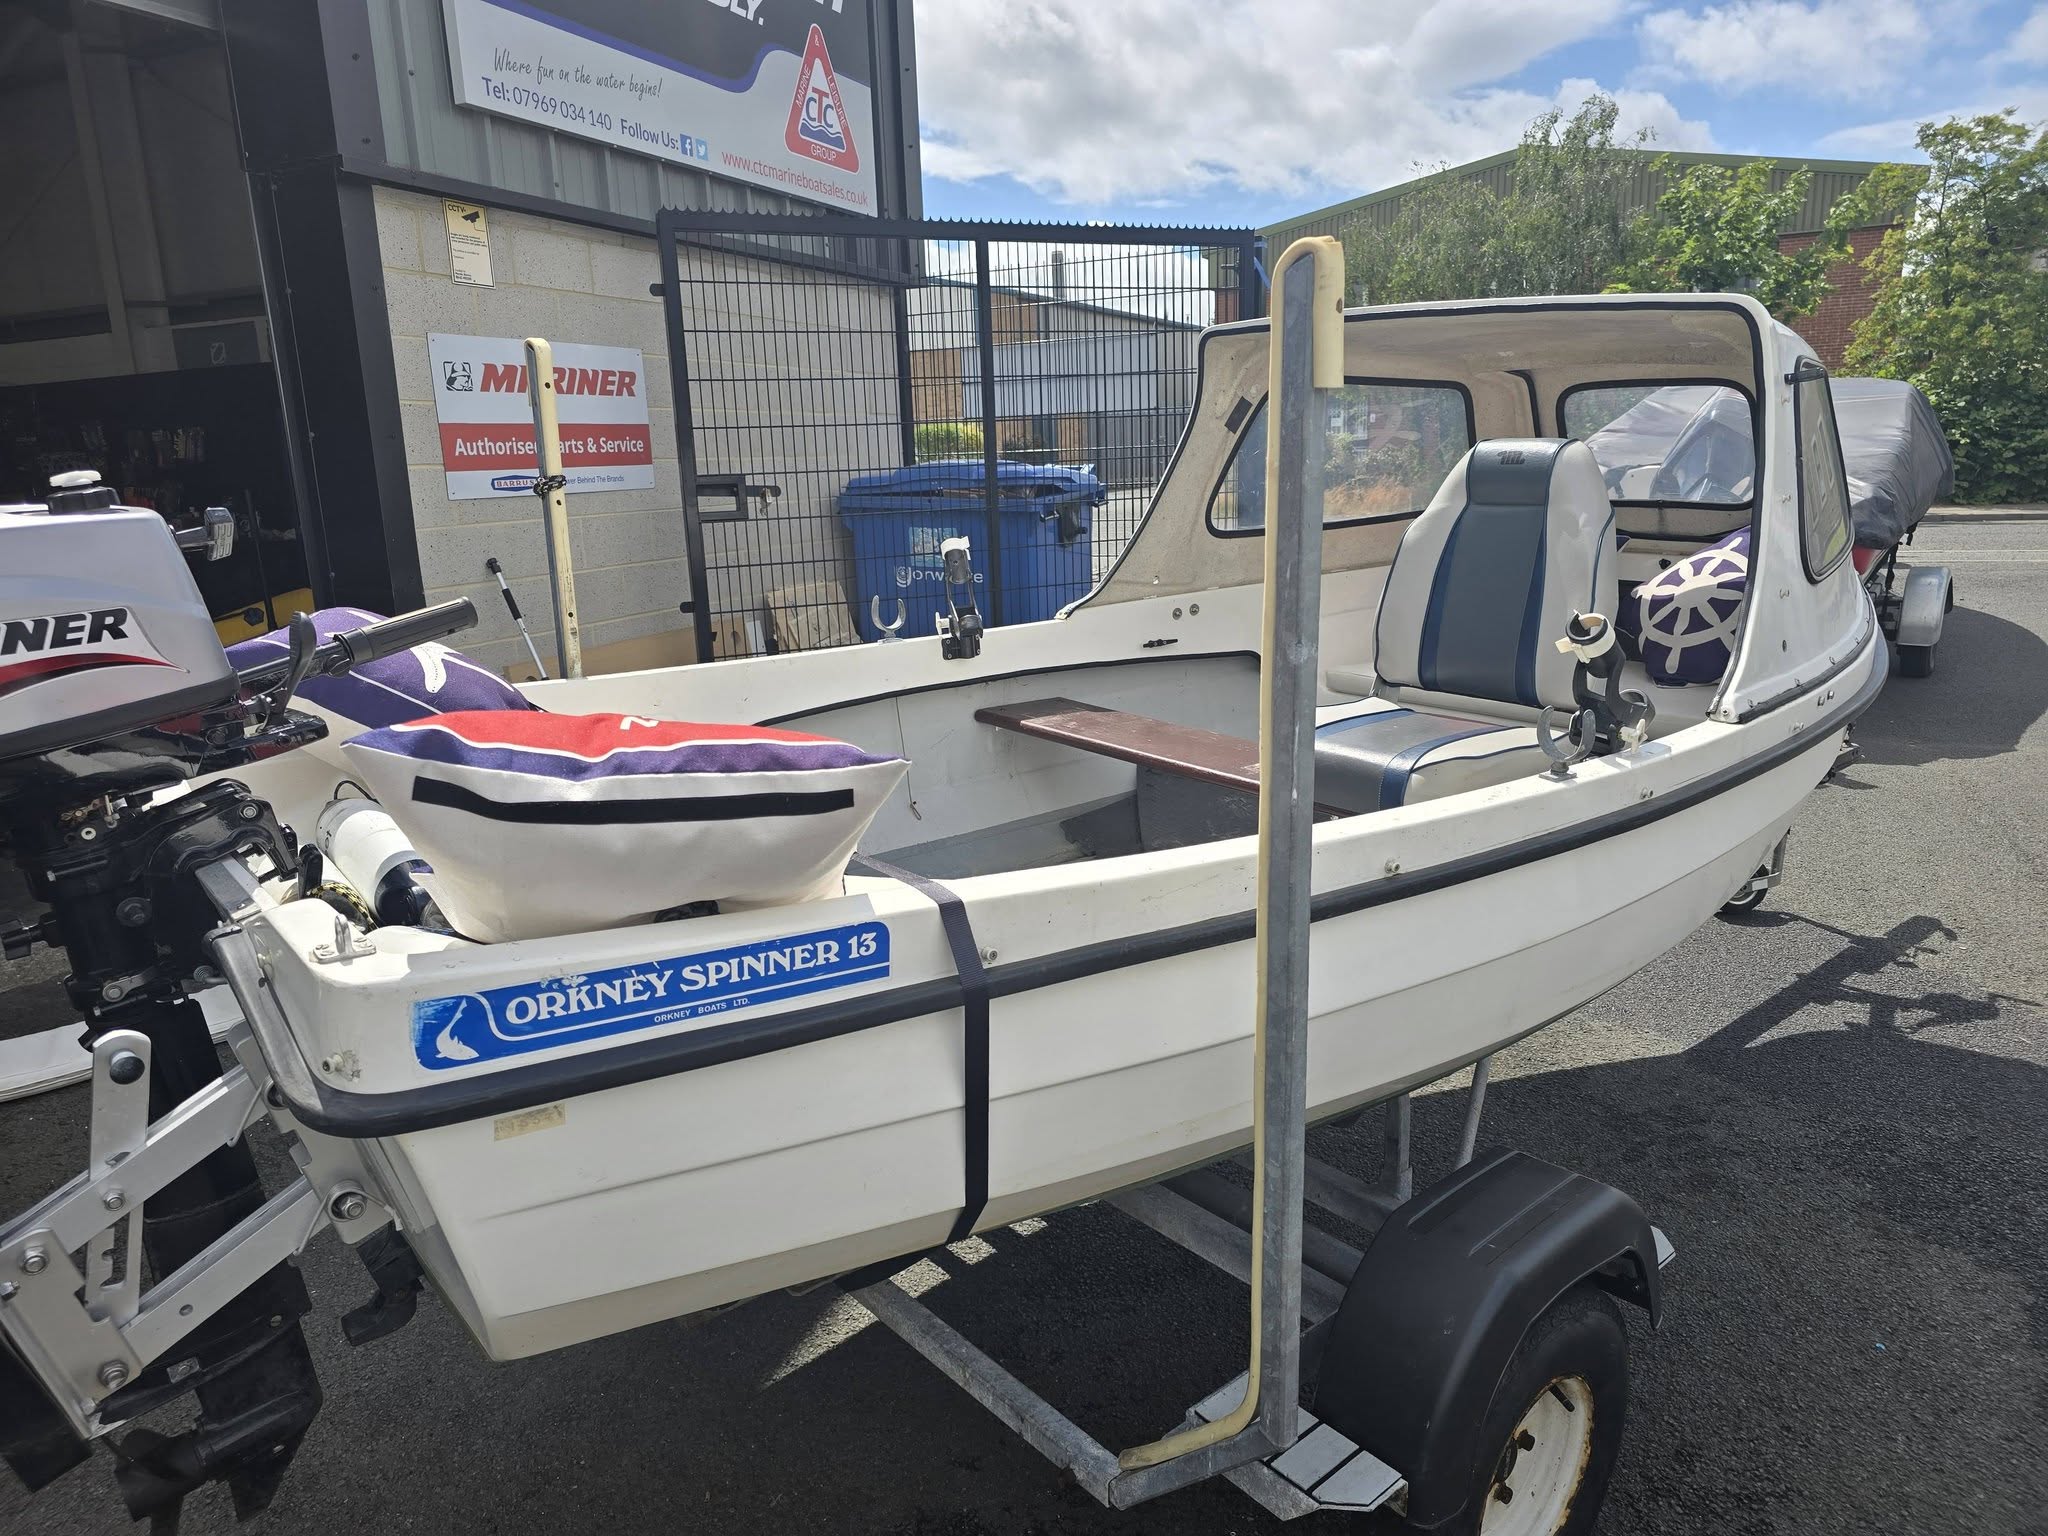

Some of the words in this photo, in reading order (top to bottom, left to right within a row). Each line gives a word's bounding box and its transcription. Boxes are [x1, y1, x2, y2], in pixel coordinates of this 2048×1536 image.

[494, 48, 532, 75] Where
[537, 56, 554, 85] fun
[558, 69, 570, 83] on
[574, 65, 591, 85] the
[596, 75, 625, 92] water
[629, 74, 663, 101] begins!
[795, 64, 811, 108] MARINE
[481, 77, 511, 102] Tel:
[513, 86, 557, 114] 07969
[560, 101, 585, 123] 034
[589, 109, 612, 131] 140
[620, 118, 659, 145] Follow
[661, 130, 679, 150] Us:
[805, 86, 834, 129] CTC
[827, 75, 848, 130] LEISURE
[810, 143, 837, 161] GROUP
[722, 151, 869, 207] www.ctcmarineboatsales.co.uk
[447, 203, 465, 214] CCTV
[455, 437, 538, 456] Authorise
[559, 439, 584, 454] arts
[587, 437, 597, 453] &
[600, 436, 644, 453] Service
[577, 476, 595, 484] Behind
[596, 475, 606, 483] The
[607, 475, 625, 483] Brands
[505, 969, 674, 1025] ORKNEY
[680, 940, 840, 992] SPINNER
[847, 932, 877, 959] 13
[654, 1008, 691, 1023] ORKNEY
[698, 1002, 727, 1014] BOATS
[733, 997, 751, 1007] LTD.
